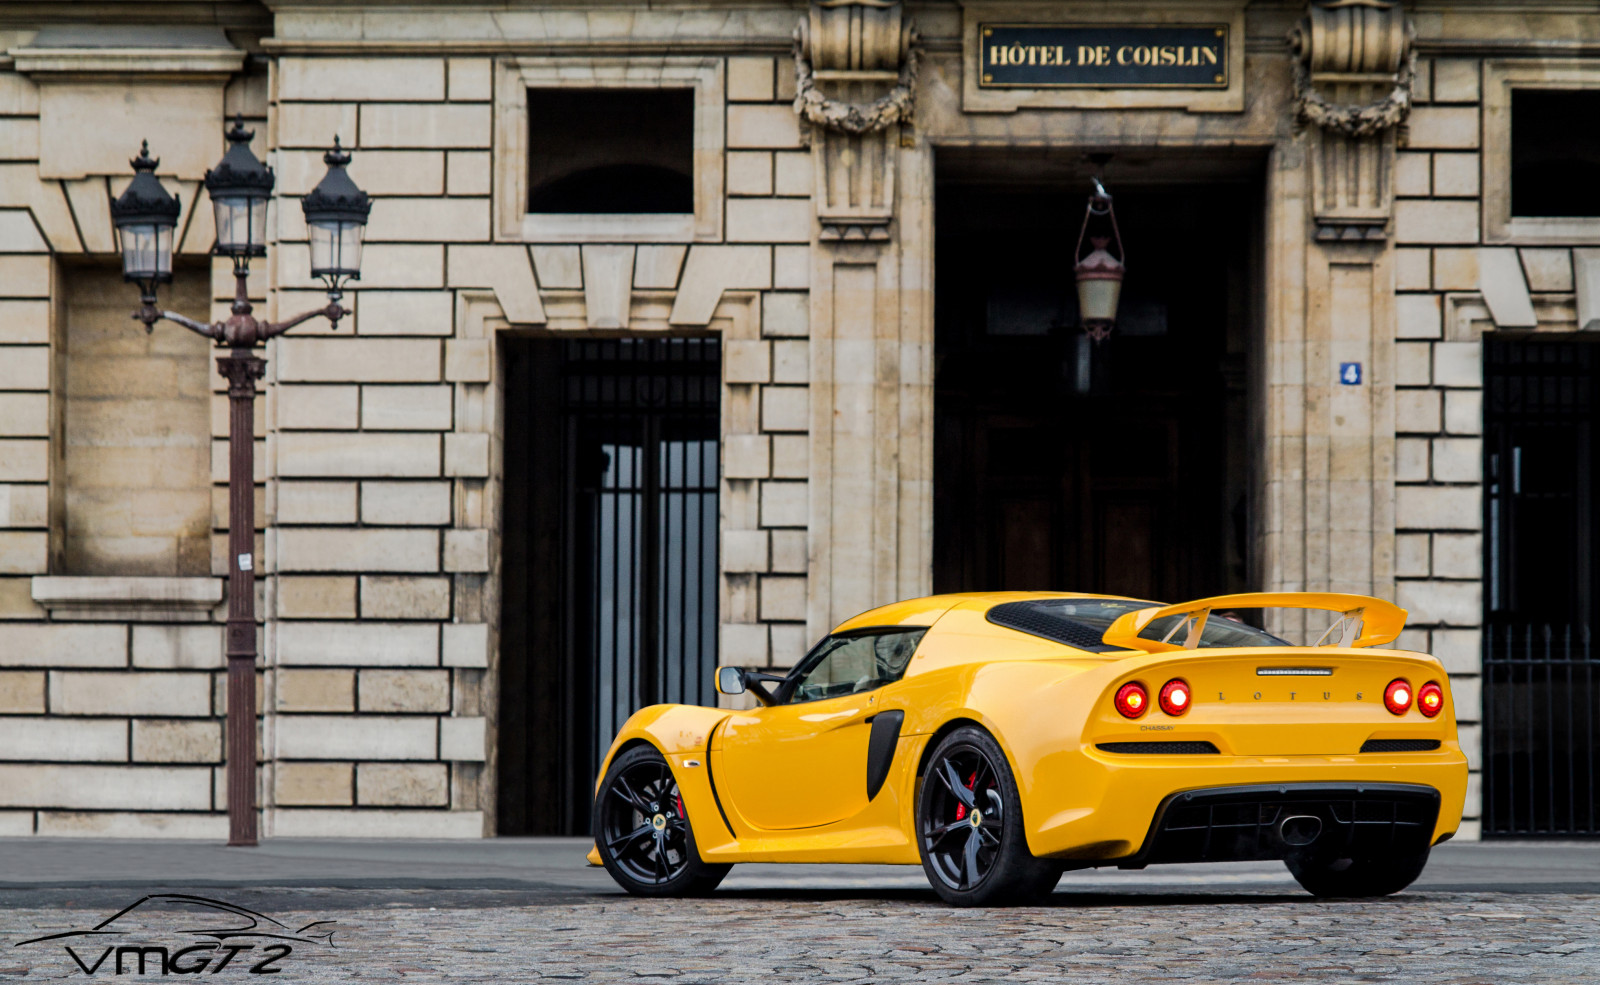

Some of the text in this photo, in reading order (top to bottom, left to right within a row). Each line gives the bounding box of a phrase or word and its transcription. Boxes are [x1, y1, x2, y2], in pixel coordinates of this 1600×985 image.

[989, 41, 1218, 66] HÔTEL DE COISLIN
[1344, 364, 1358, 383] 4
[1218, 691, 1363, 701] LOTUS
